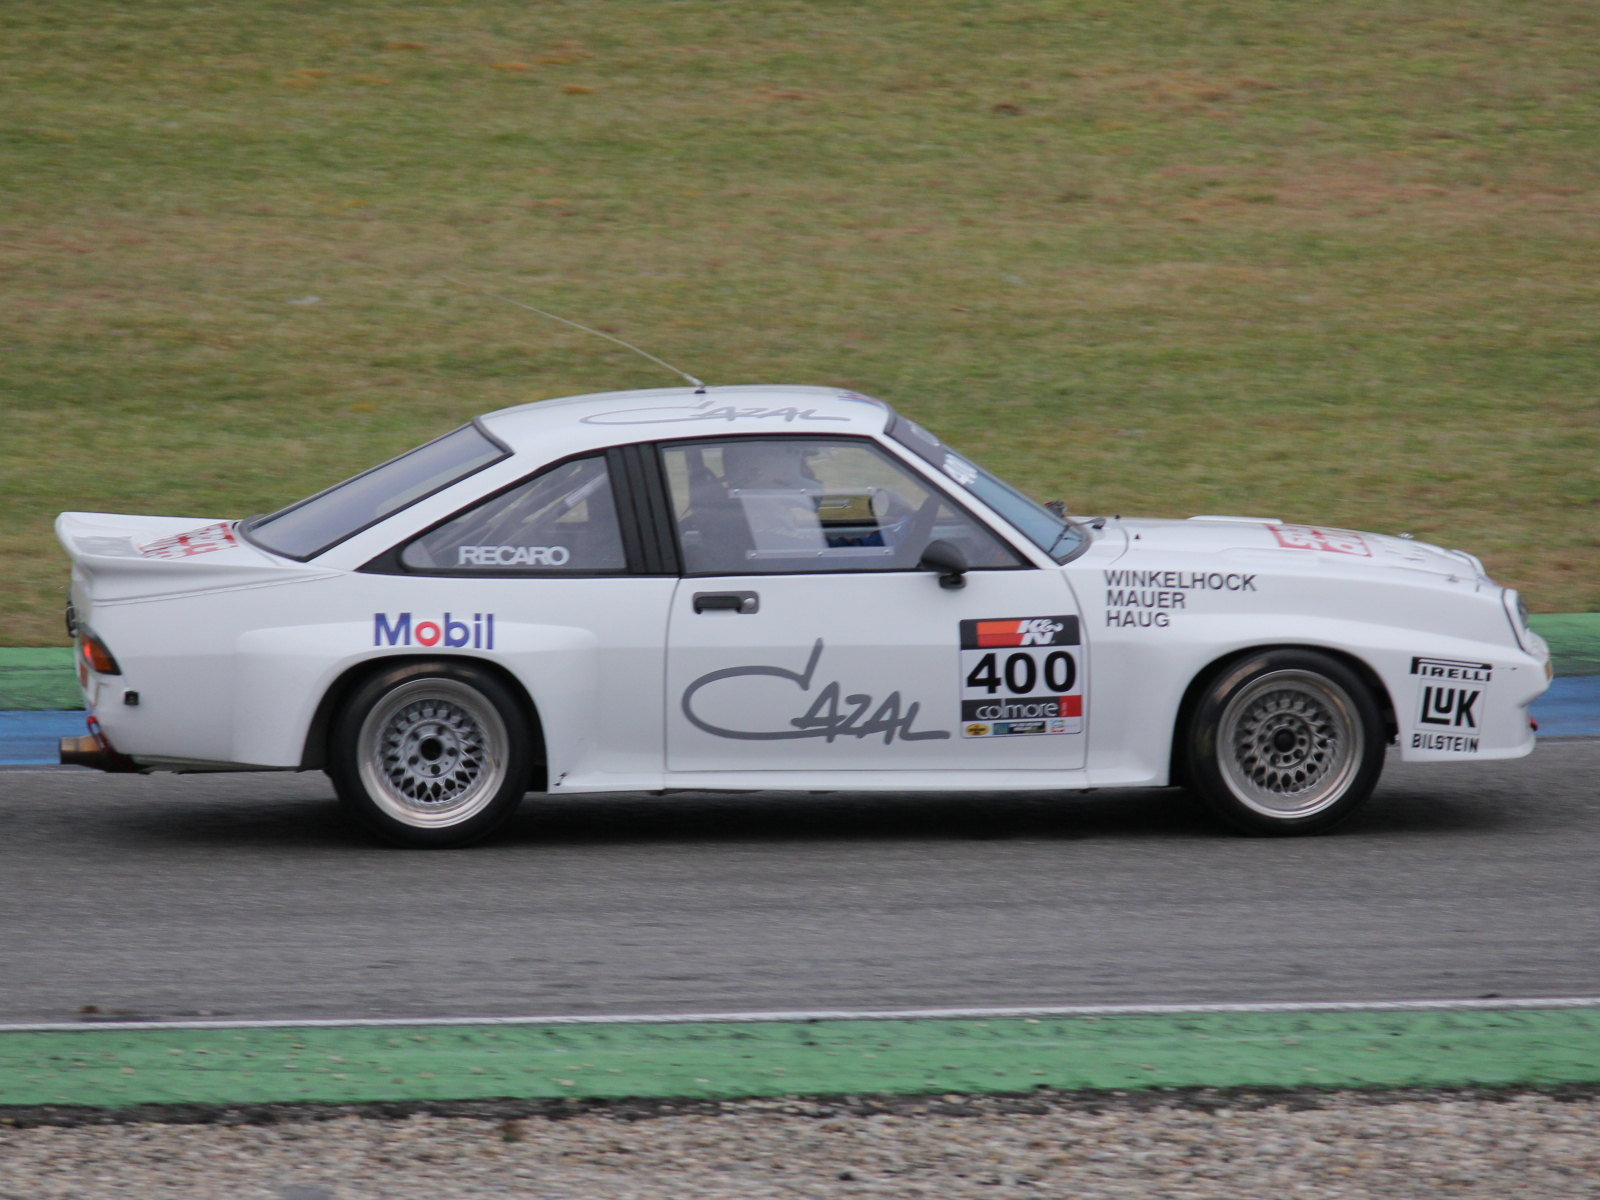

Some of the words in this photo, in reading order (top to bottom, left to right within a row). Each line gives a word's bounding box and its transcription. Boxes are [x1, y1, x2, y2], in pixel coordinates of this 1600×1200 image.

[458, 546, 570, 565] RECARO
[1103, 570, 1257, 591] WINKELHOCK
[1106, 590, 1186, 609] MAUER
[1106, 610, 1170, 627] HAUG
[374, 612, 494, 650] Mobil
[966, 651, 1076, 694] 400
[1411, 656, 1492, 682] PIRELLI
[975, 699, 1059, 720] colmore
[1412, 733, 1480, 753] BILSTEIN
